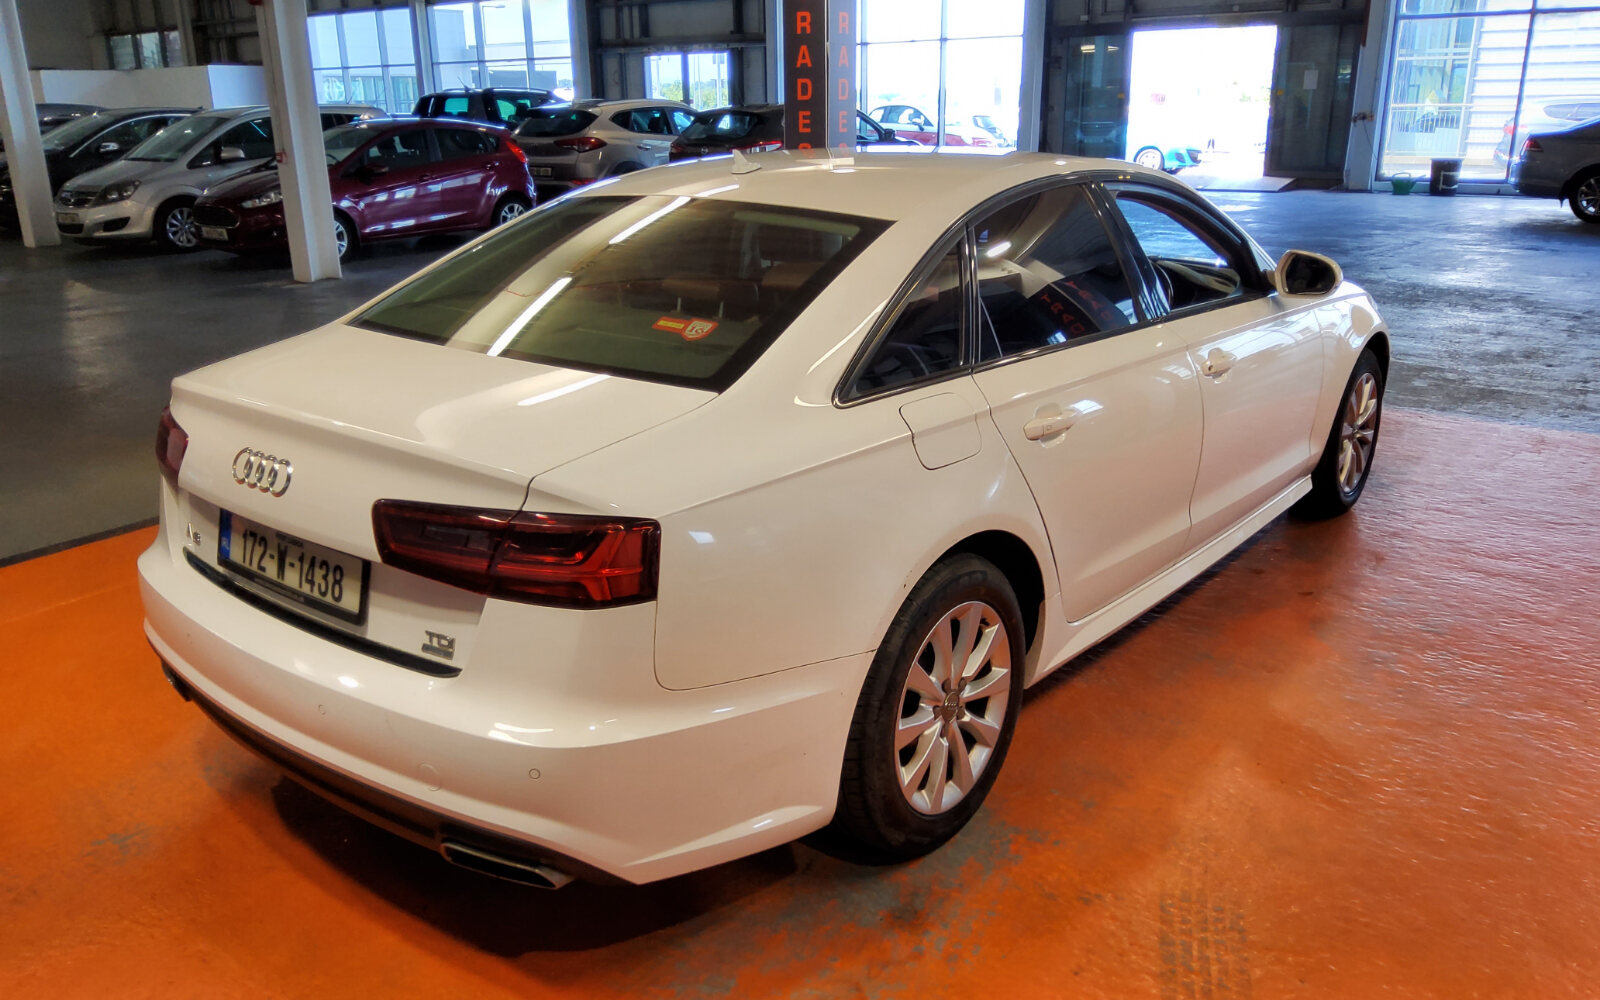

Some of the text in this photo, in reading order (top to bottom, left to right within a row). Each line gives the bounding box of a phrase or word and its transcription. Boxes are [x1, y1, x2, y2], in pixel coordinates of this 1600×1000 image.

[796, 11, 813, 149] RADE
[839, 12, 849, 148] RADE
[242, 528, 345, 603] 172-W-1438
[425, 630, 456, 652] TDI
